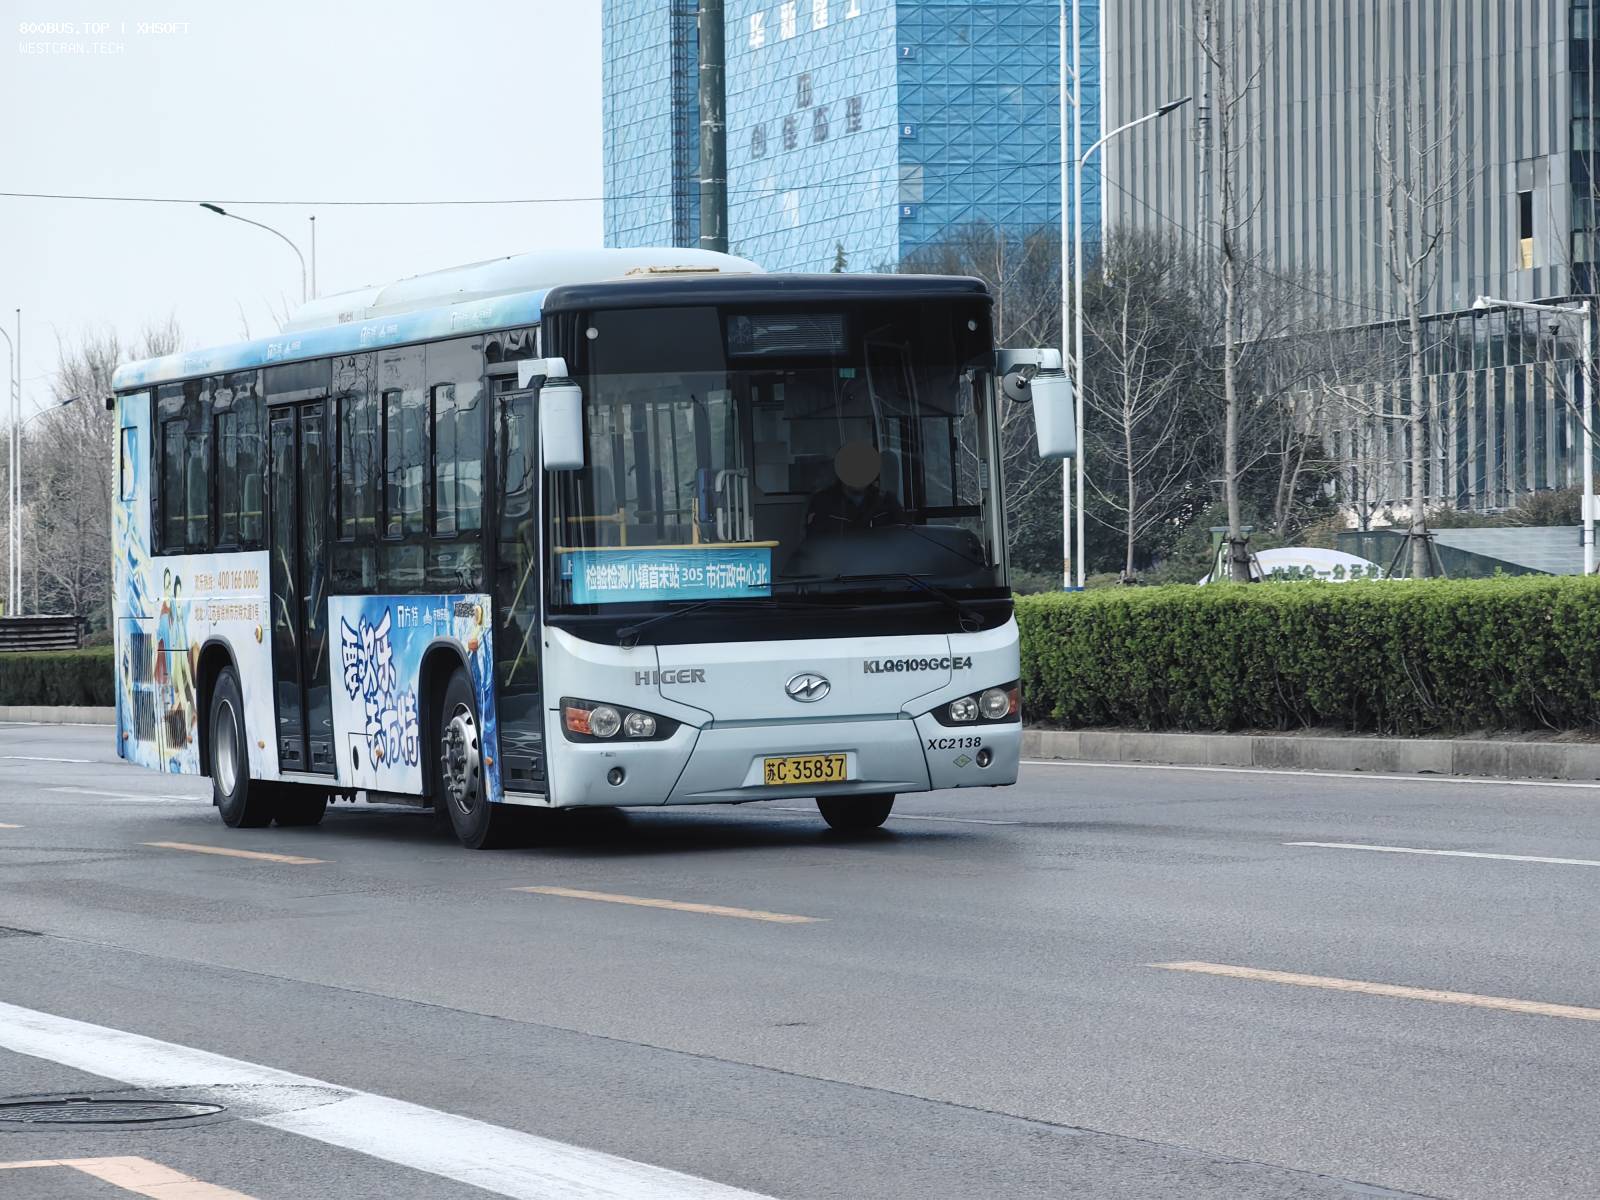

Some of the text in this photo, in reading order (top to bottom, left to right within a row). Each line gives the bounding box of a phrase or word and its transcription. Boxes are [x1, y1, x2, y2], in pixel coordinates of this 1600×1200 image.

[903, 48, 910, 56] 7
[904, 126, 911, 135] 6
[904, 206, 911, 215] 5
[218, 570, 230, 590] 400
[231, 570, 242, 589] 166
[586, 563, 768, 591] 检验检测小镇首末站 305 市行政中心北
[863, 656, 973, 674] KLQ6109GCE4
[635, 668, 706, 686] HIGER
[928, 736, 982, 751] XC2138
